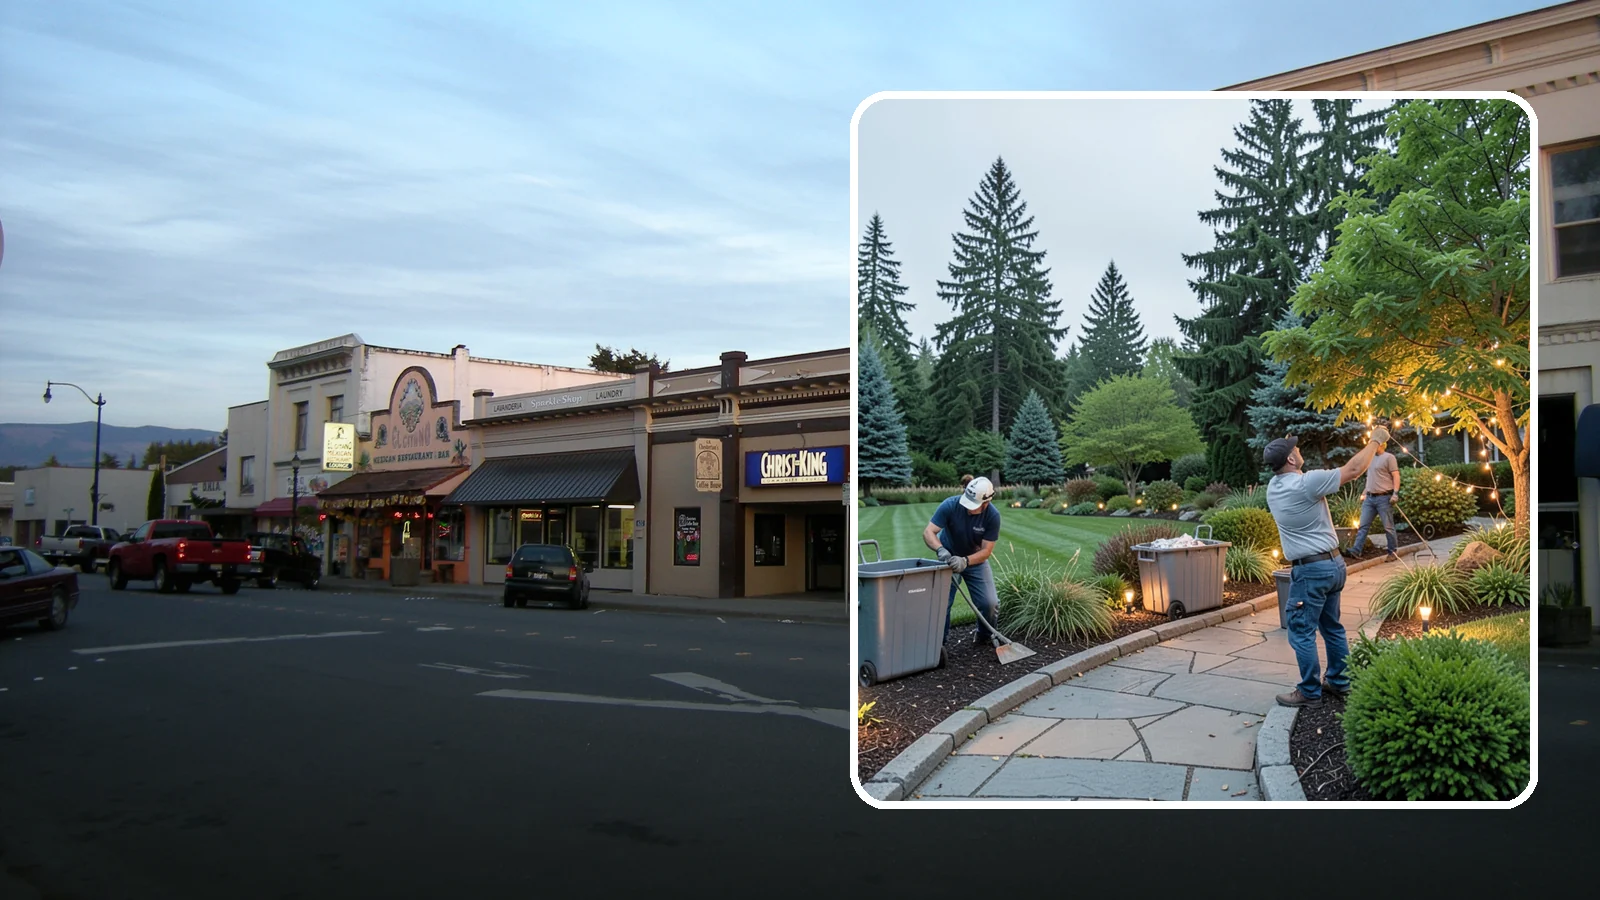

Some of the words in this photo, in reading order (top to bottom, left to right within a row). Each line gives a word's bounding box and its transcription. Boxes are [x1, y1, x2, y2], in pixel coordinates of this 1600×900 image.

[493, 402, 523, 413] LAVANDERIA
[531, 396, 560, 409] Sparkle
[562, 394, 582, 406] Shop
[595, 388, 624, 400] LAUNDRY
[373, 455, 396, 464] MEXICAN
[397, 451, 433, 462] RESTAURANT
[438, 450, 450, 459] BAR
[761, 452, 797, 478] CHRIST
[799, 450, 827, 476] KING
